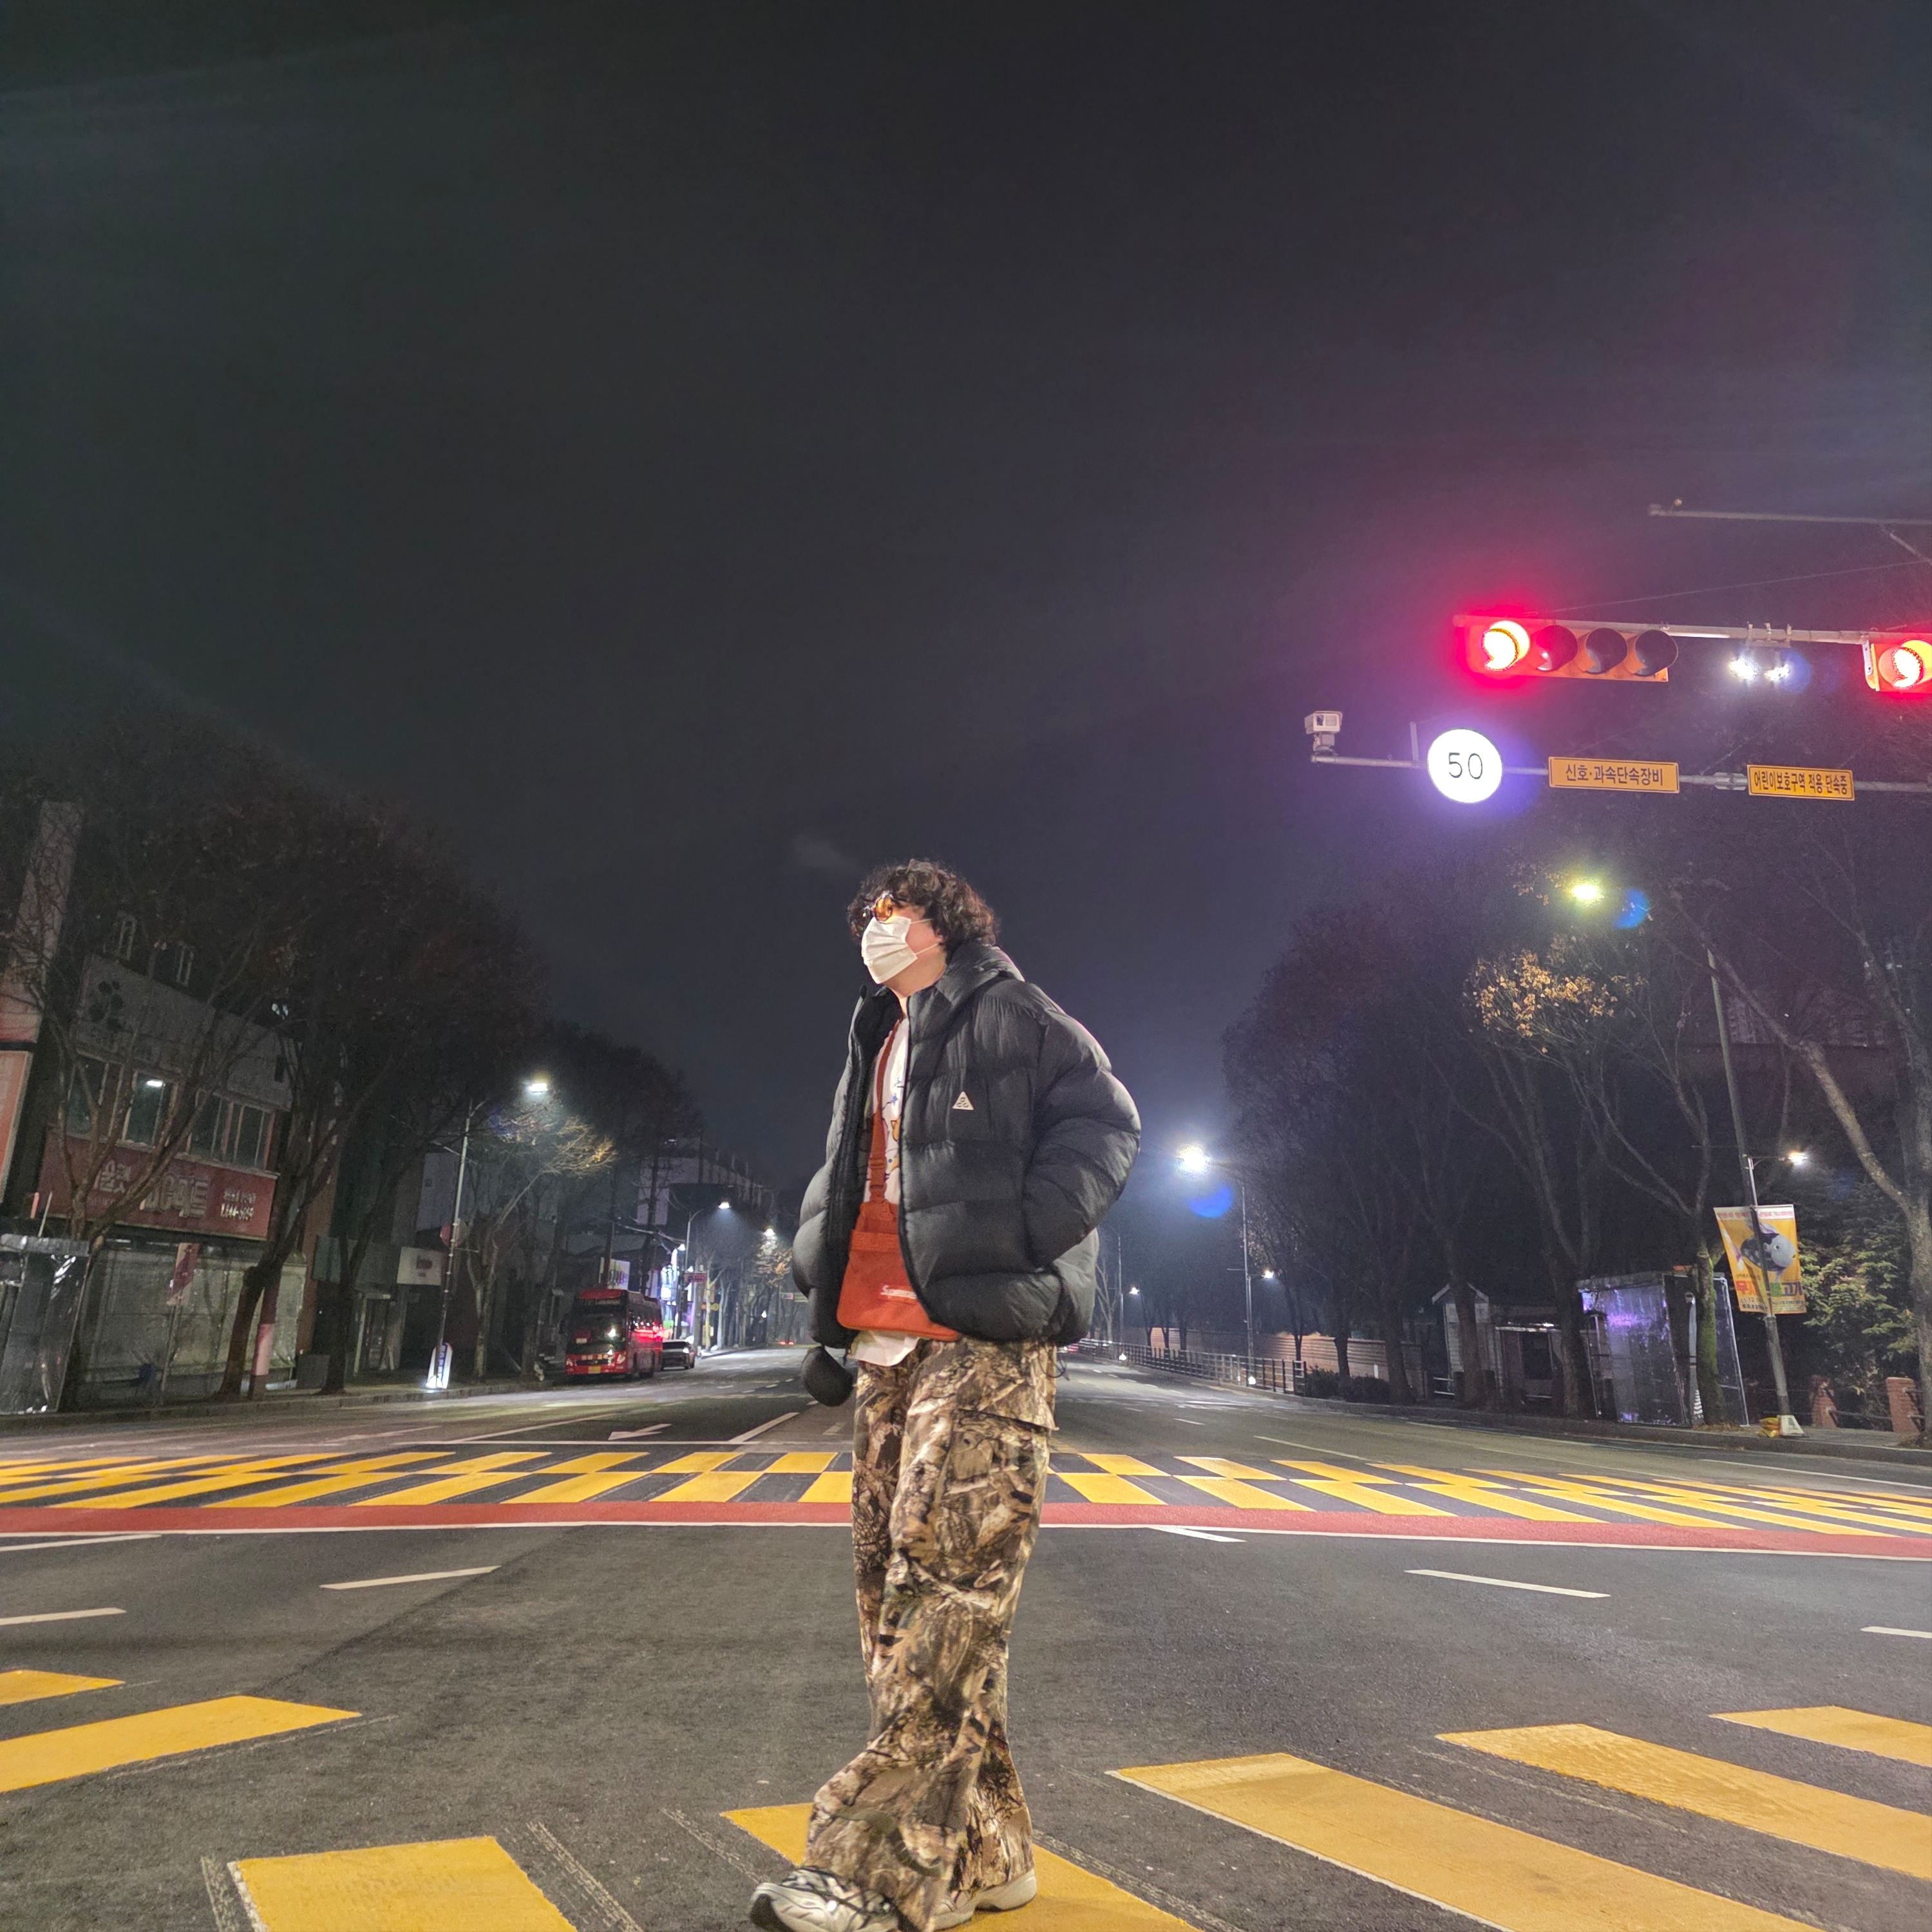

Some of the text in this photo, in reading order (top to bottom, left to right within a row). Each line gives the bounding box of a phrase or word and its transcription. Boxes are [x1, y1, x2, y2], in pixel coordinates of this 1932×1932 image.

[1449, 752, 1482, 779] 50
[1566, 764, 1663, 786] 신호·과속단속장비
[1754, 771, 1847, 795] 어린이보호구역 적용 단속중
